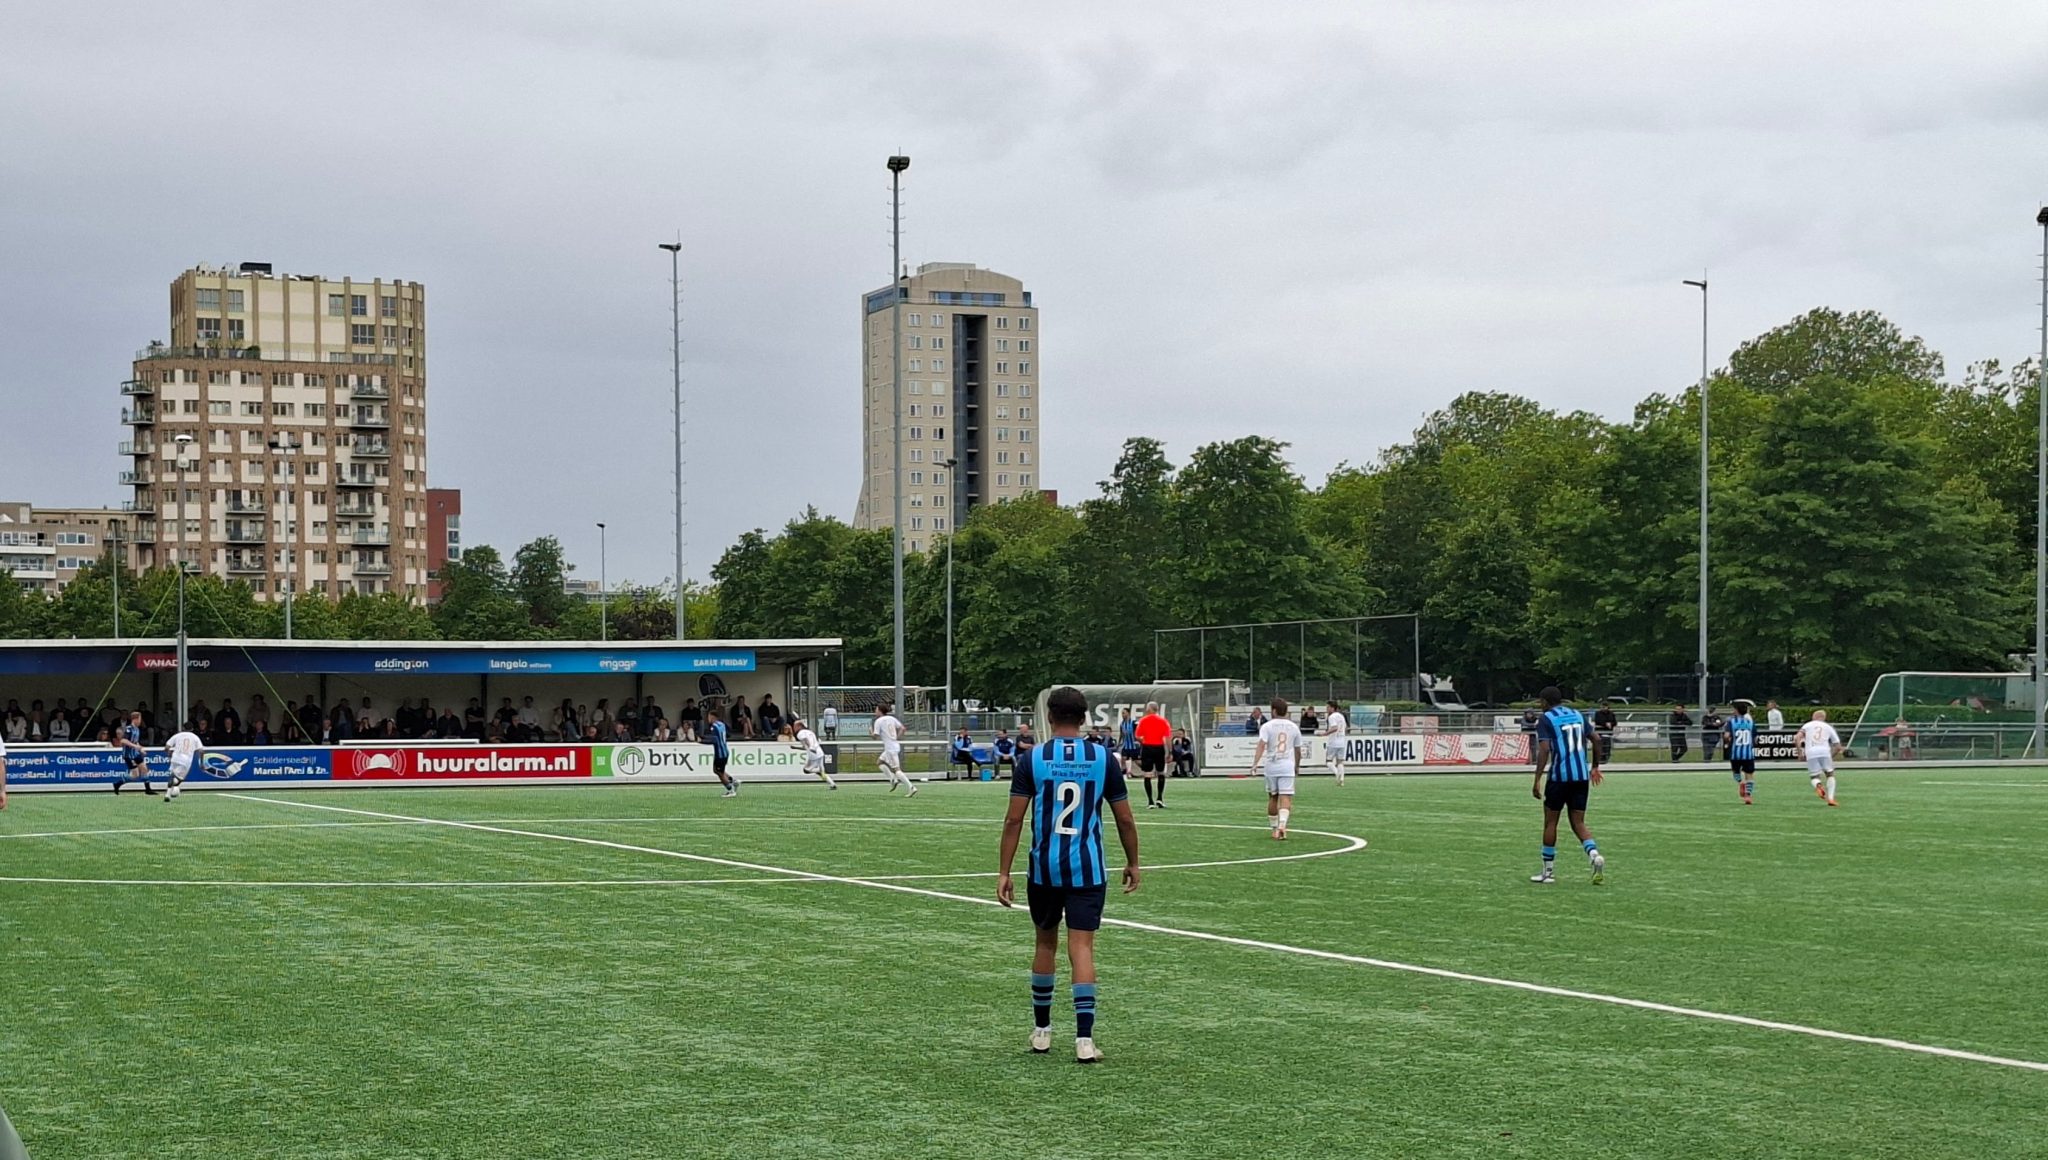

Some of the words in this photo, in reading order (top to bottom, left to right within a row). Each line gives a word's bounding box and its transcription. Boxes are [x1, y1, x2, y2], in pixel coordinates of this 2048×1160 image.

[186, 659, 210, 669] roup
[720, 658, 748, 666] FRIDAY
[1277, 732, 1288, 753] 8
[1735, 730, 1750, 746] 20
[1755, 735, 1796, 744] SIOTHE
[1345, 739, 1416, 762] ARREWIEL
[1772, 747, 1805, 757] SOYE
[417, 750, 576, 773] huuralarm.nl
[649, 748, 694, 772] brix
[698, 748, 807, 766] mkelaars
[253, 767, 283, 776] Marcel
[1054, 781, 1081, 835] 2
